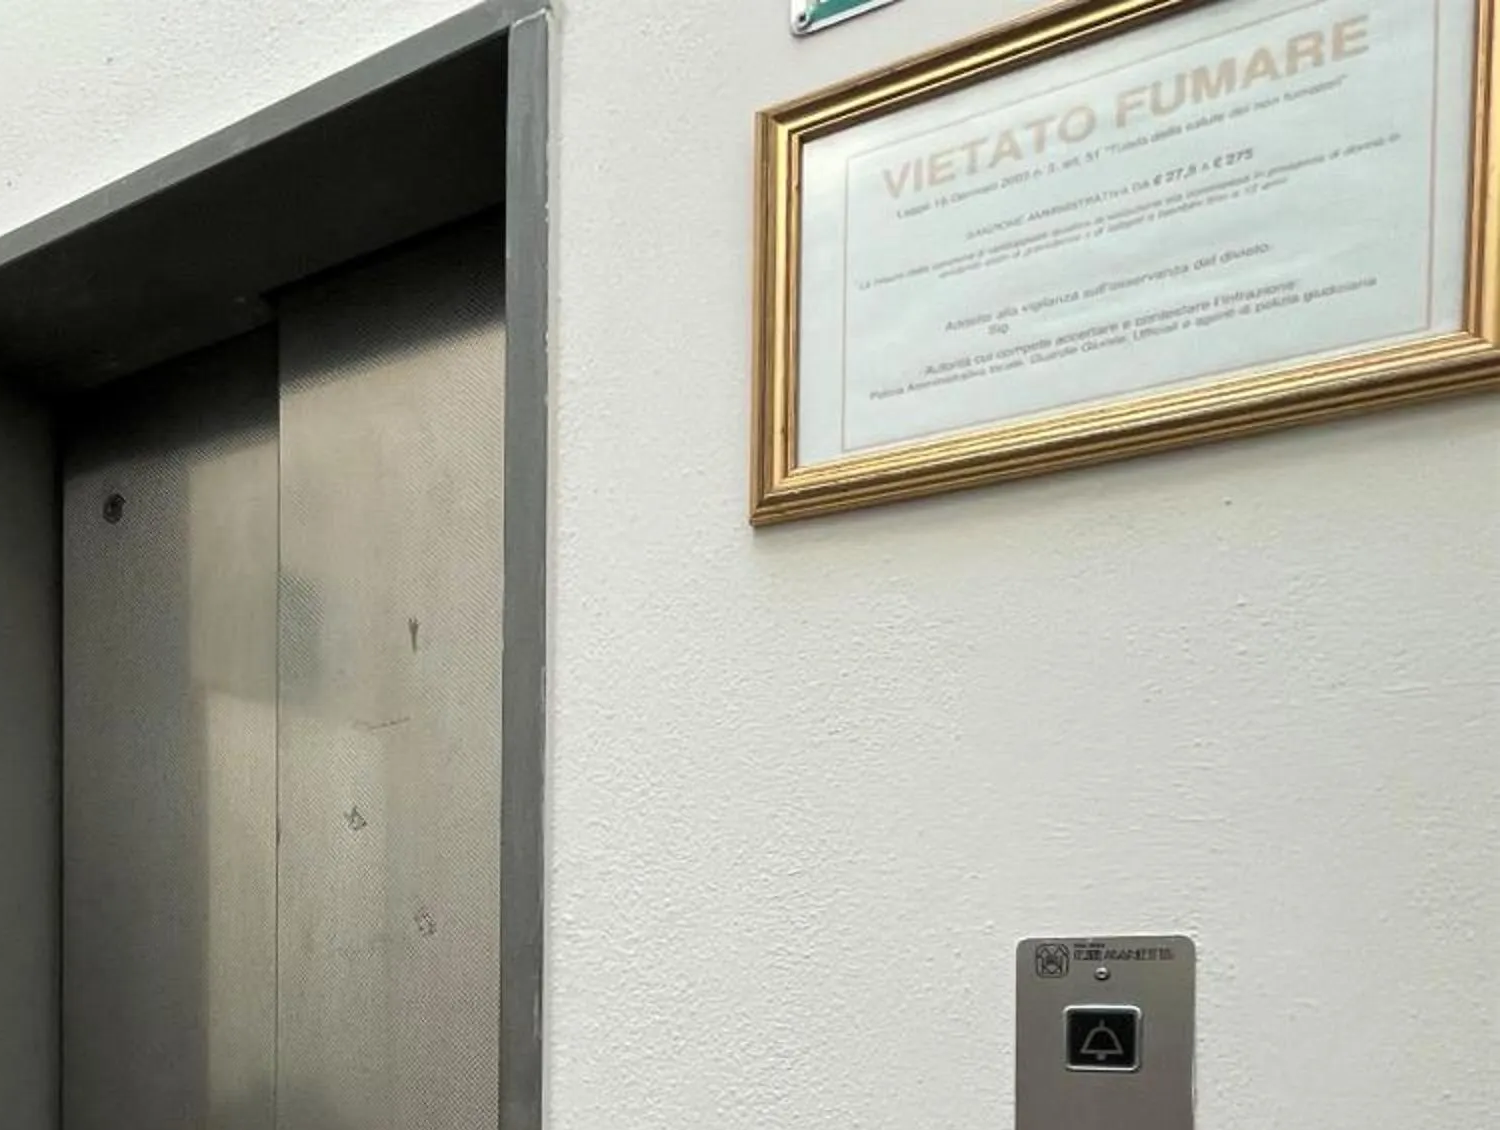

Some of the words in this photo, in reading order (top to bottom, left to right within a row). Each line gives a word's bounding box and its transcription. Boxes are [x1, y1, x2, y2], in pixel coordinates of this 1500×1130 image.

[881, 104, 1097, 199] VIETATO
[1115, 13, 1369, 129] FUMARE
[1226, 147, 1253, 165] 275
